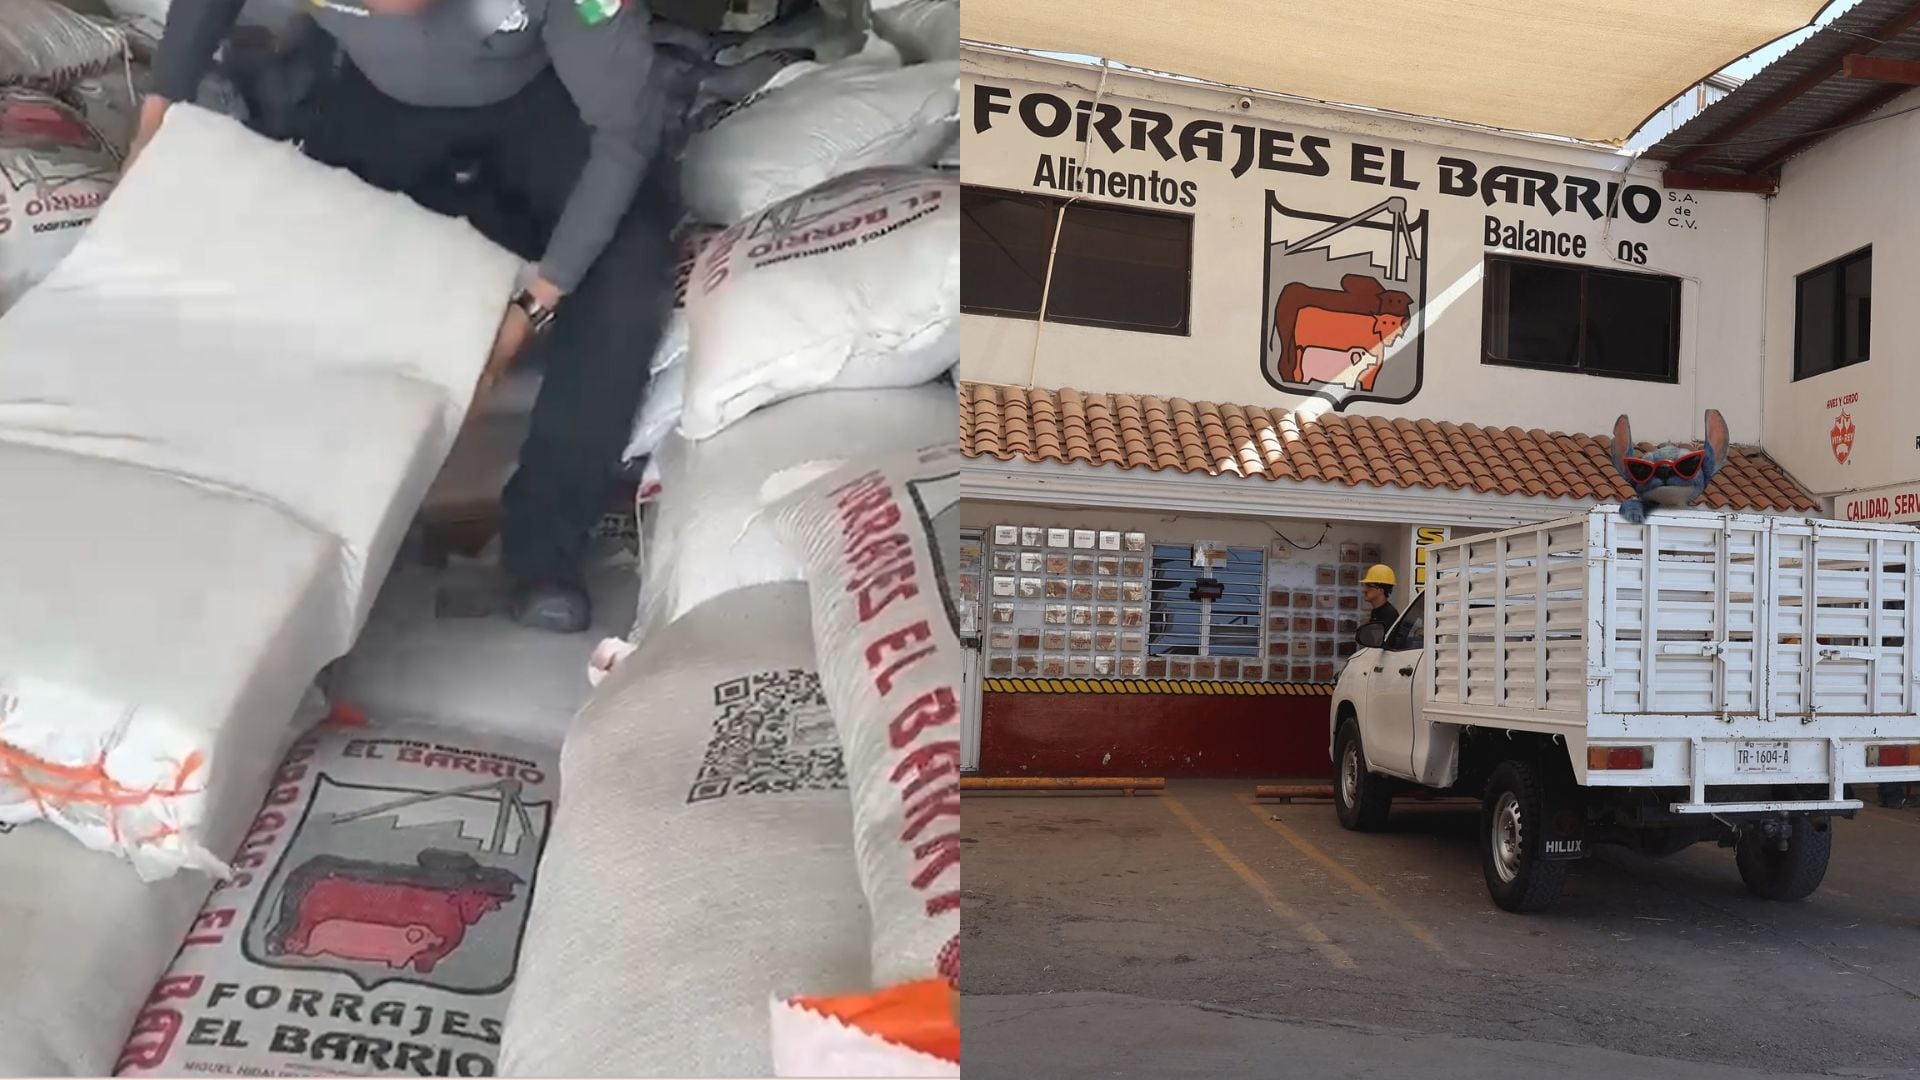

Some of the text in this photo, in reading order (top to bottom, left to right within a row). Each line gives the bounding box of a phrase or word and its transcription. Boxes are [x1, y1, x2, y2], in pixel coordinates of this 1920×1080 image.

[974, 84, 1662, 224] FORRAJES EL BARRIO
[1033, 153, 1198, 208] Alimentos
[1668, 191, 1698, 204] S.A.
[1668, 217, 1698, 230] C.V.
[1674, 205, 1691, 217] de
[1846, 496, 1892, 521] CALIDAD,
[396, 748, 546, 785] BARRIO
[1738, 750, 1789, 764] TR-1604-A
[1545, 840, 1582, 853] HILUX
[206, 982, 502, 1045] FORRAJES
[186, 1017, 495, 1078] EL BARRIO
